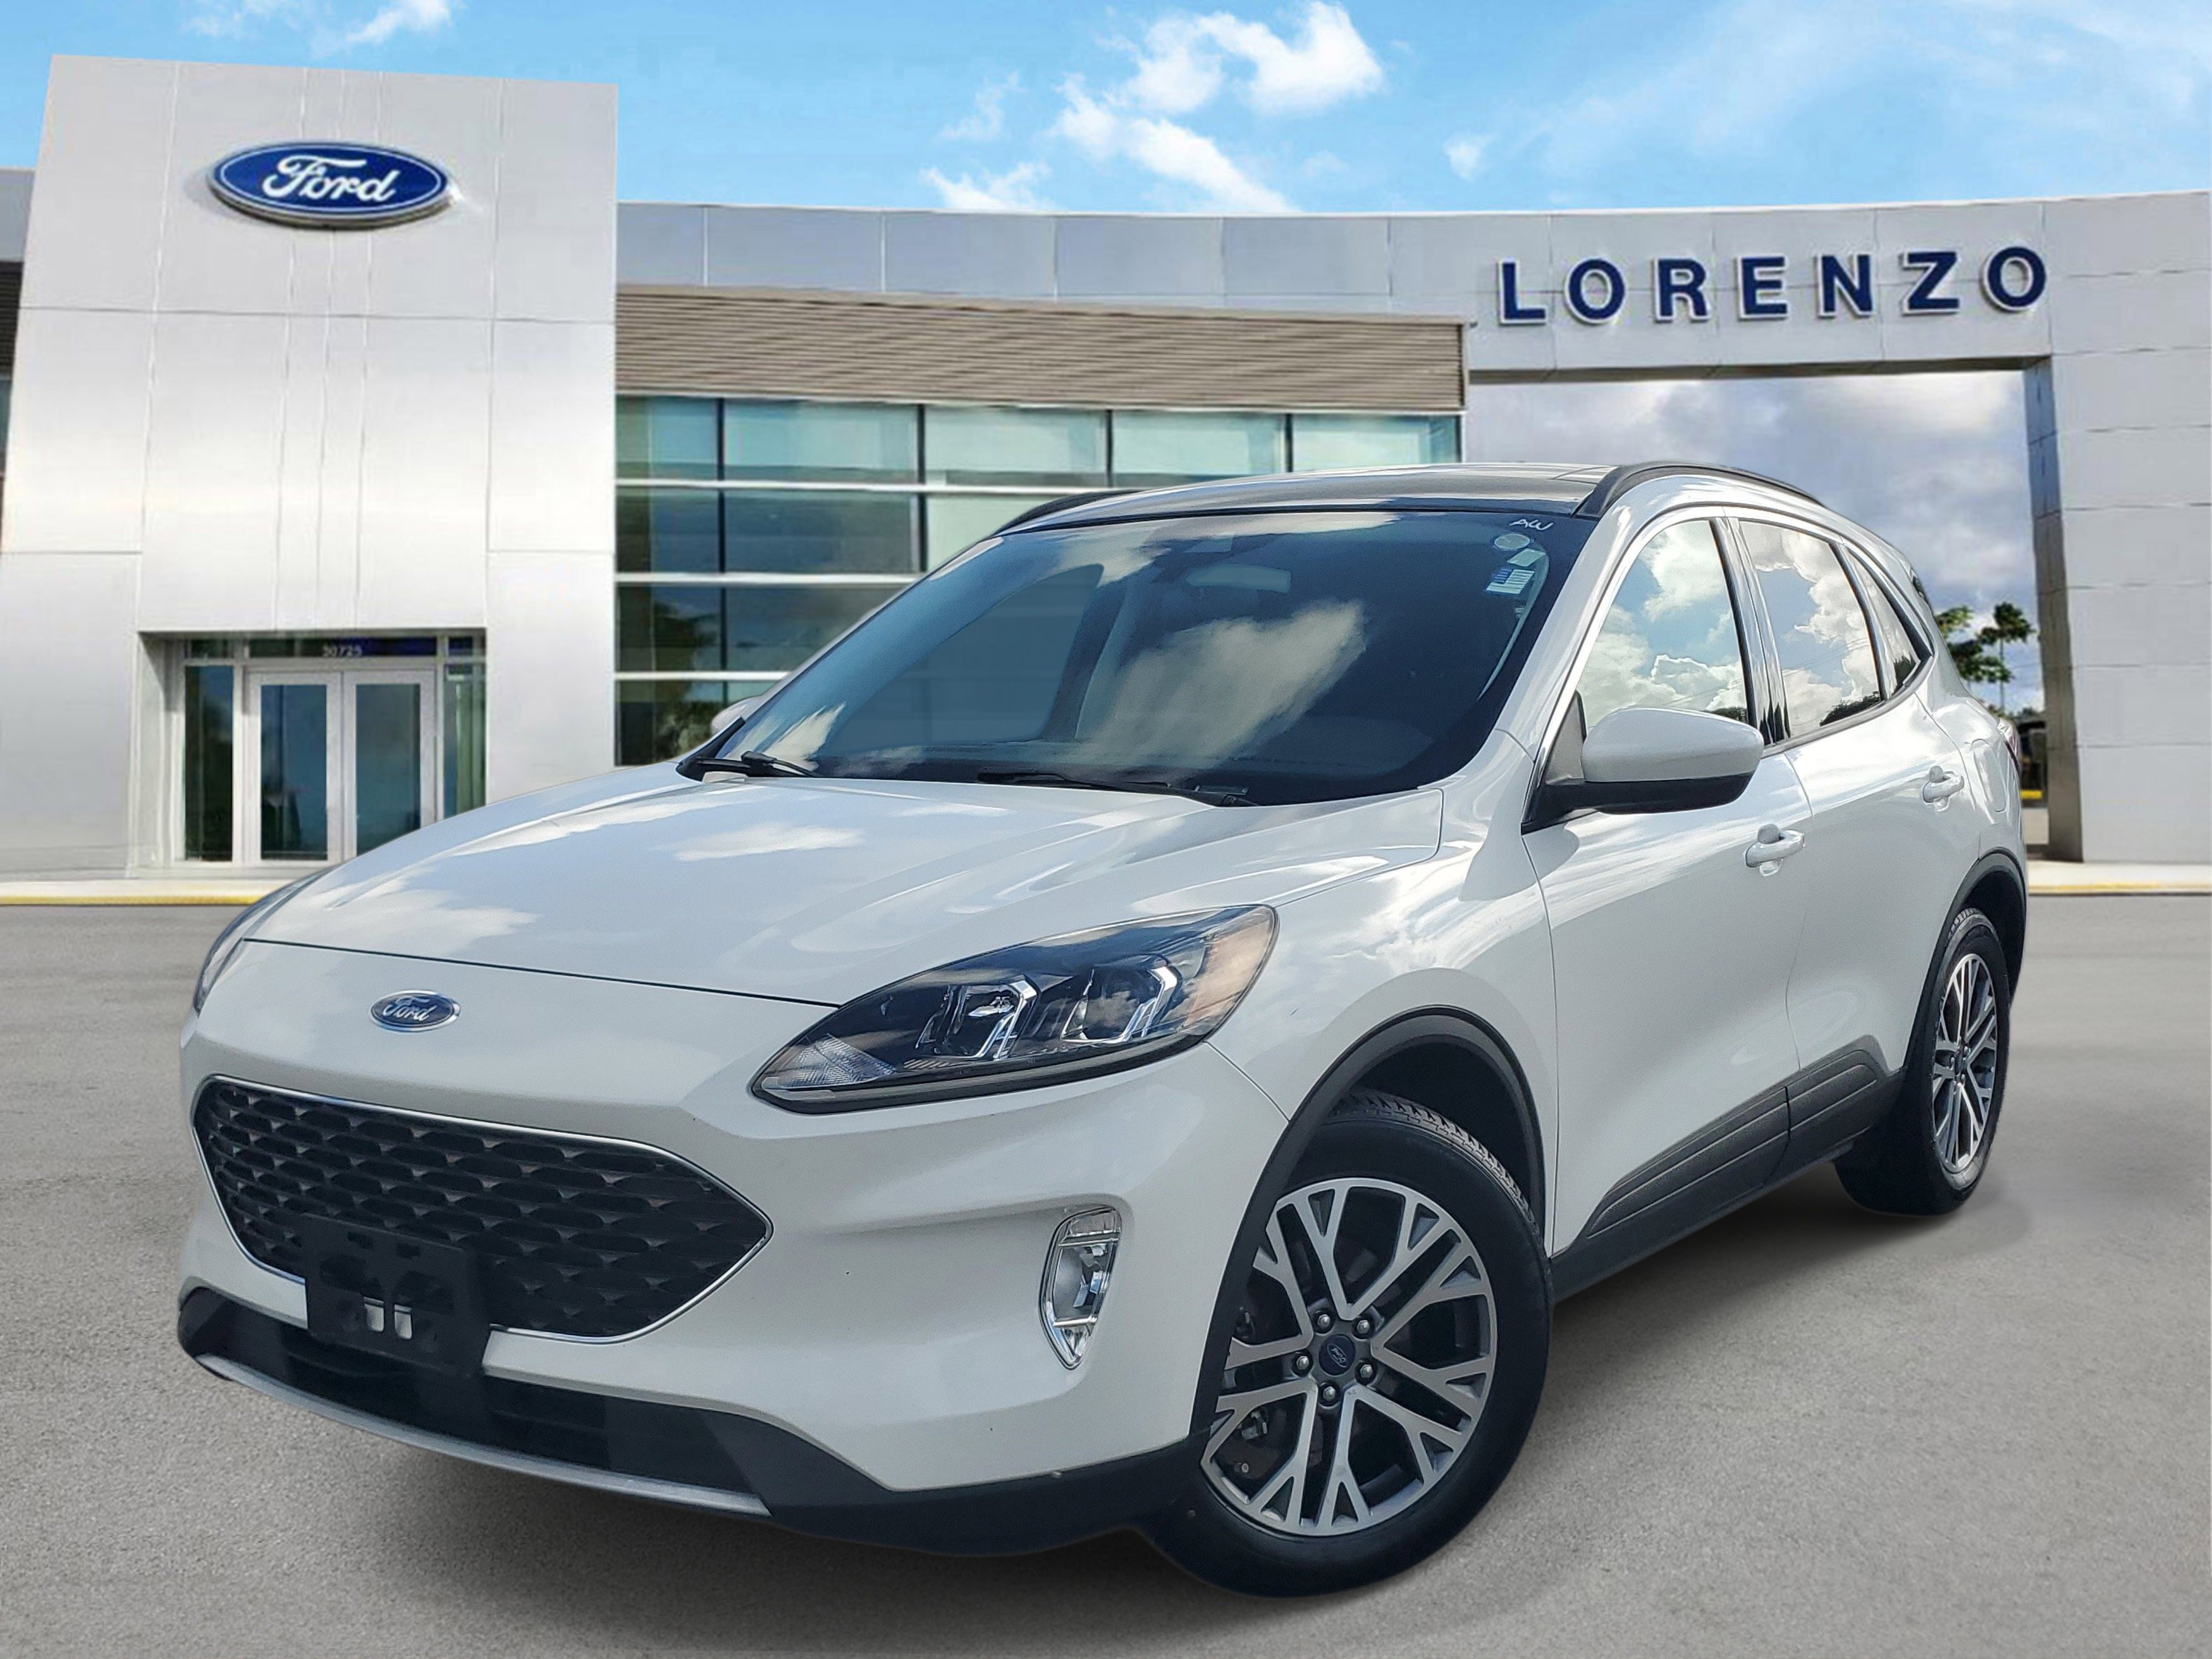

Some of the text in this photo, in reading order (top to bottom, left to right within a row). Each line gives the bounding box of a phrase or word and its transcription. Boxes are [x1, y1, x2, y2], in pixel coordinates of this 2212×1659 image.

[262, 154, 401, 202] Ford
[1498, 247, 2048, 324] LORENZO
[382, 996, 438, 1021] Ford
